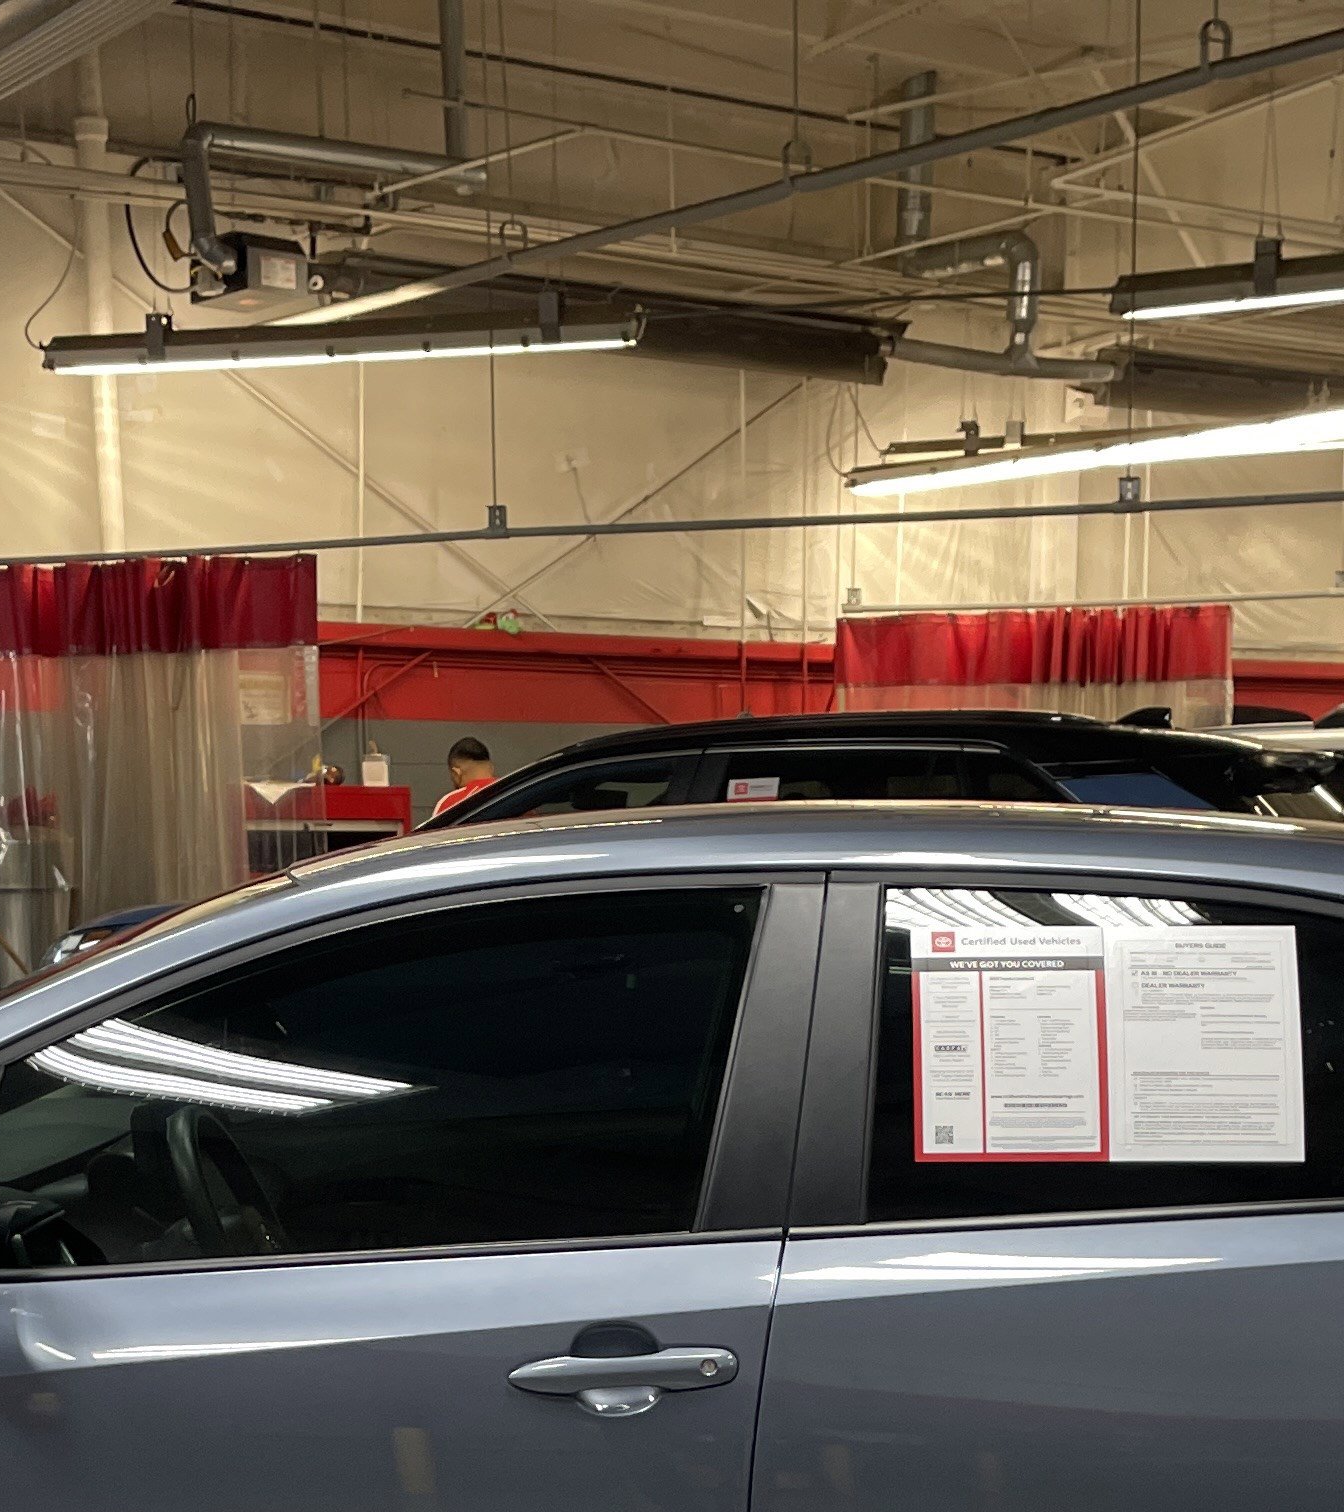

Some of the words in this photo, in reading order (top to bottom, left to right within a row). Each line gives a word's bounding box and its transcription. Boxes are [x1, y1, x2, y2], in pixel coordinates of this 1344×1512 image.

[960, 937, 1006, 946] Certified
[1010, 937, 1036, 946] Used
[1039, 936, 1081, 946] Vehicles
[949, 960, 977, 969] WE'VE
[979, 960, 1000, 969] GOT
[1001, 960, 1020, 969] YOU
[1021, 960, 1065, 968] COVERED
